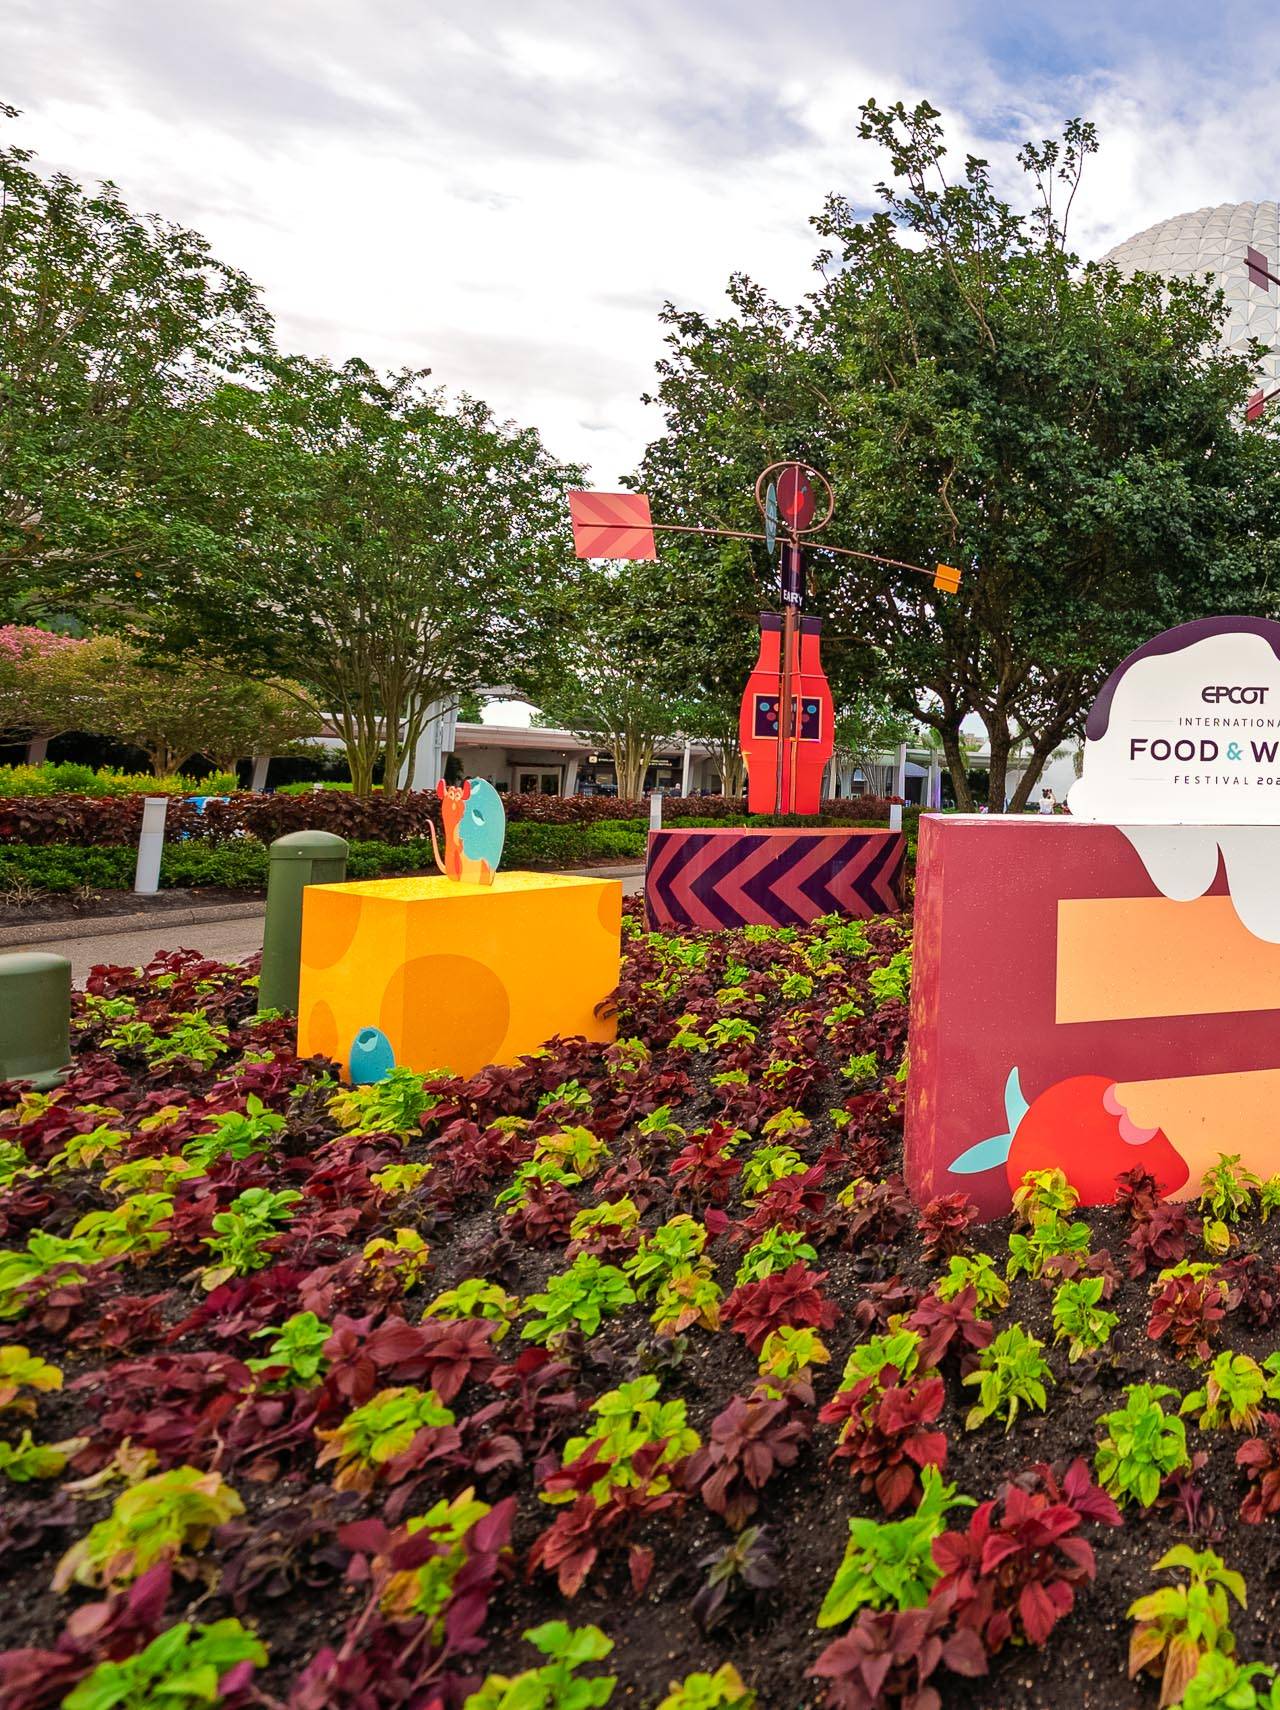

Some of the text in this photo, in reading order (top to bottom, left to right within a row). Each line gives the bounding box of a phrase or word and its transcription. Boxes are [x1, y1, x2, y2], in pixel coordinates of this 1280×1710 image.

[1201, 686, 1269, 704] EPCOT
[1130, 738, 1219, 761] FOOD
[1226, 741, 1244, 761] &
[1174, 775, 1249, 786] FESTIVAL
